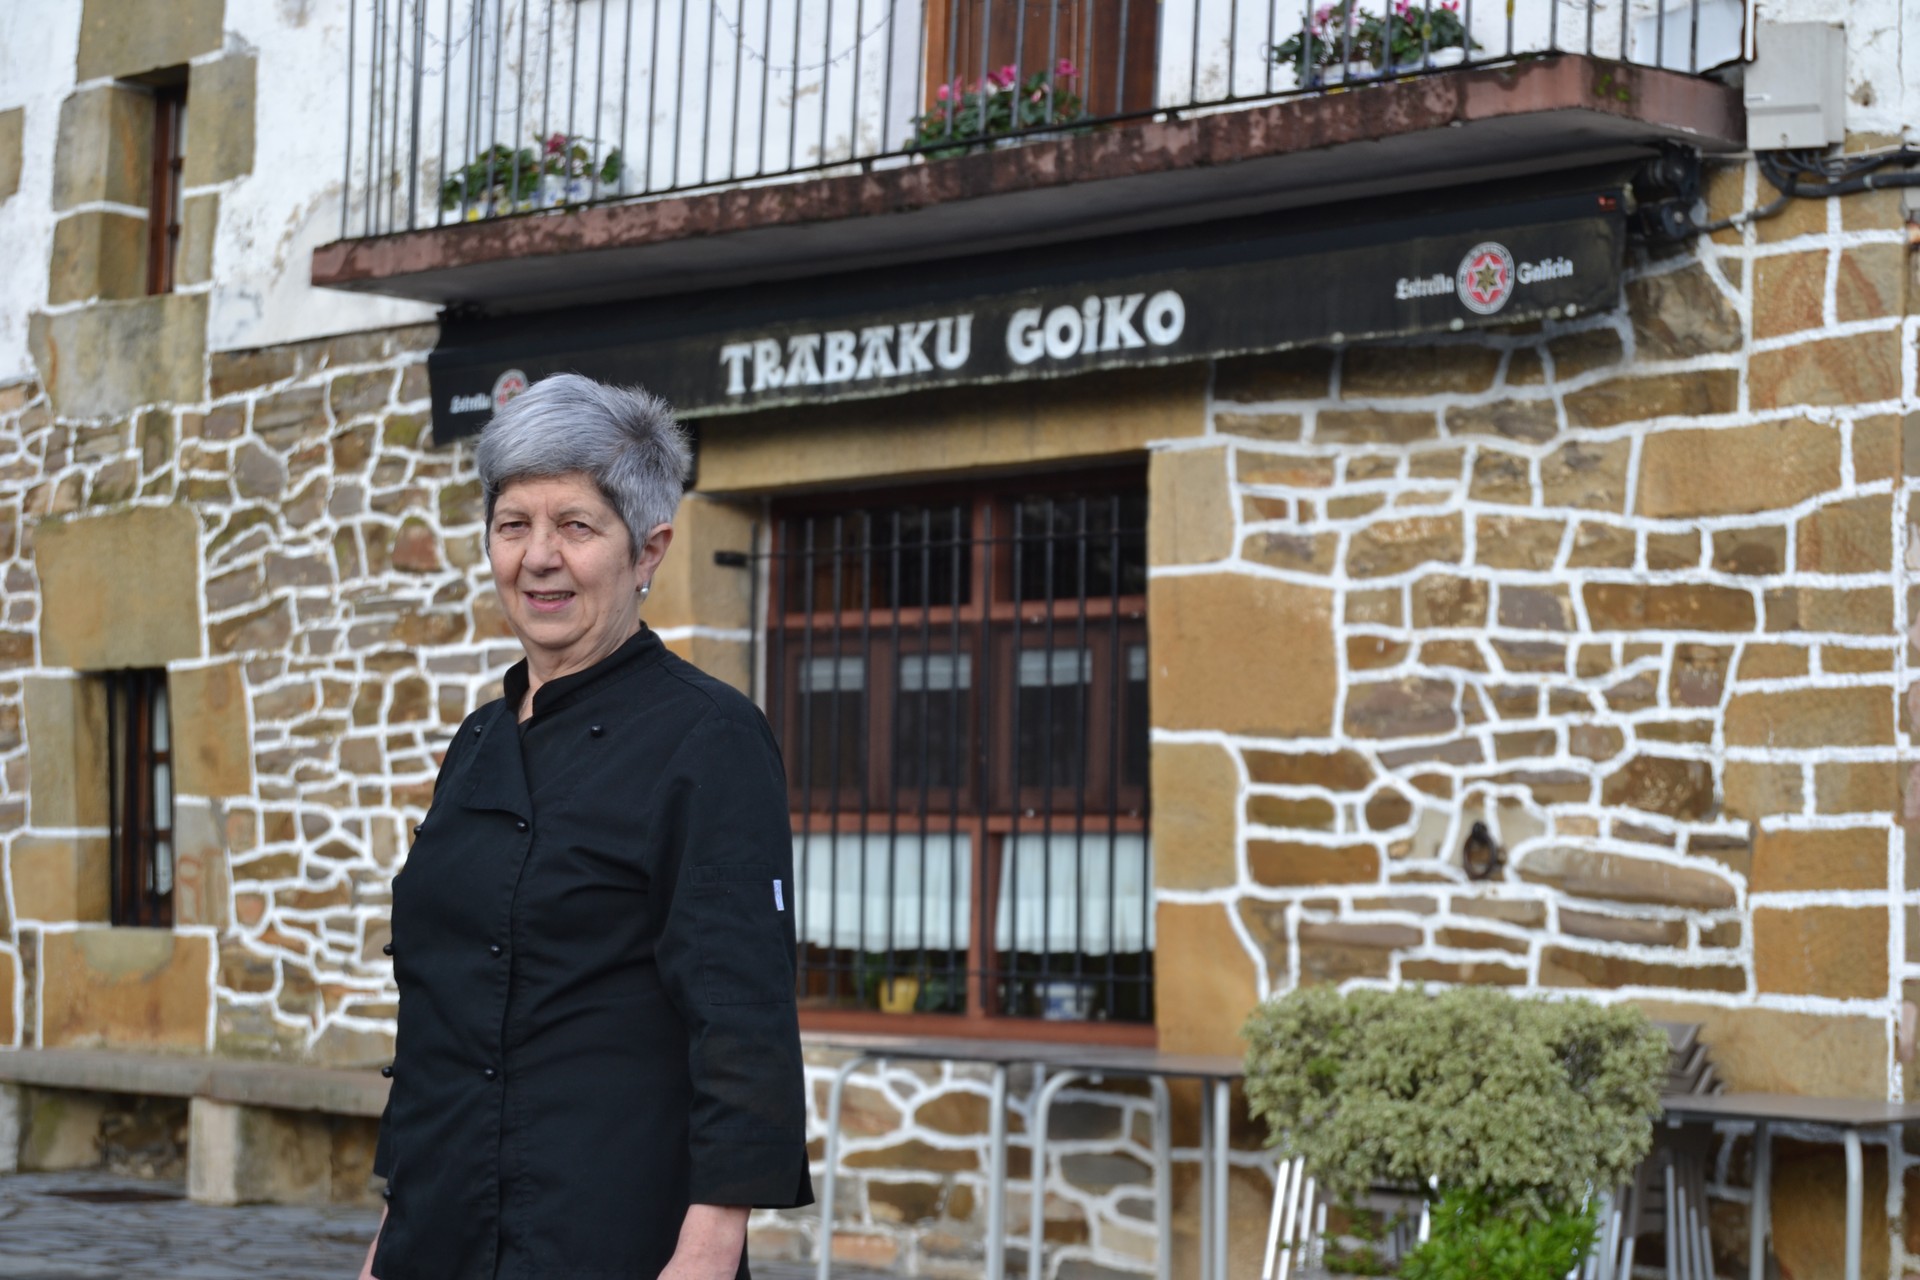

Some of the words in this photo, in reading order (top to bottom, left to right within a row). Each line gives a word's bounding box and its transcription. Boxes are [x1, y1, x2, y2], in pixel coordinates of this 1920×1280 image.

[1395, 273, 1454, 300] Estrella
[1516, 256, 1574, 285] Galicia
[720, 313, 974, 395] TRABAKU
